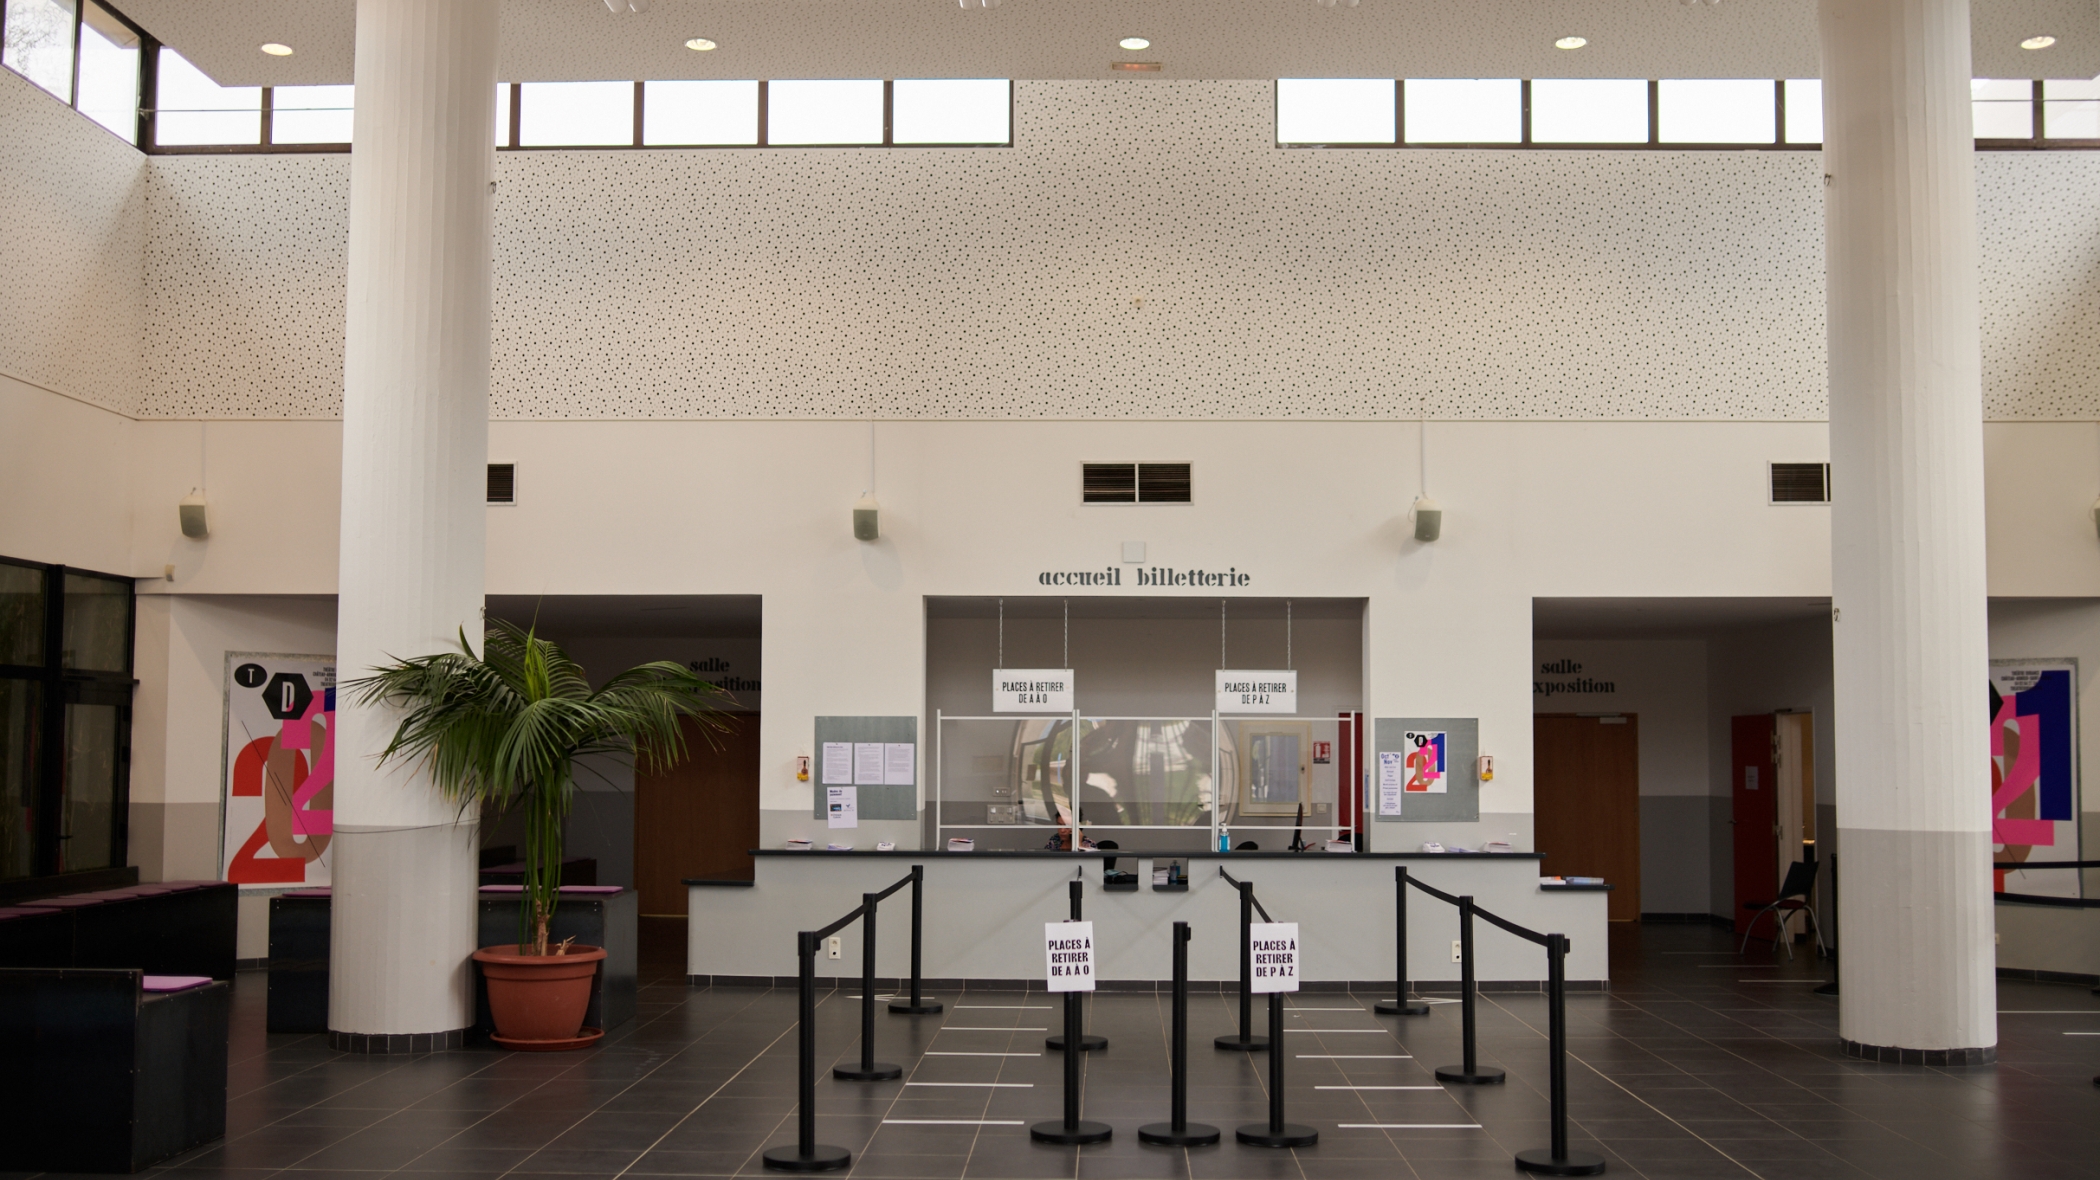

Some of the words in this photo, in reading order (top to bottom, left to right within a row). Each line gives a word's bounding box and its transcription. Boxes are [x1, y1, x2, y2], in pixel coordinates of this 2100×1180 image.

[1038, 567, 1121, 586] accueil
[1137, 567, 1250, 587] billetterie
[689, 658, 730, 672] salle
[1541, 659, 1582, 674] salle
[1002, 681, 1028, 692] PLACES
[1029, 680, 1034, 692] À
[1036, 681, 1064, 692] RETIRER
[1224, 682, 1250, 693] PLACES
[1251, 680, 1257, 693] À
[1258, 682, 1287, 693] RETIRER
[1533, 678, 1616, 697] xposition
[1019, 693, 1027, 704] DE
[1029, 693, 1034, 704] A
[1036, 692, 1041, 704] À
[1042, 693, 1048, 704] O
[1241, 694, 1251, 705] DE
[1252, 694, 1257, 705] P
[1259, 692, 1264, 705] À
[1265, 694, 1270, 705] Z
[1048, 939, 1082, 951] PLACES
[1084, 936, 1091, 949] À
[1253, 940, 1287, 951] PLACES
[1289, 937, 1296, 951] À
[1051, 951, 1089, 964] RETIRER
[1256, 953, 1293, 964] RETIRER
[1051, 965, 1063, 977] DE
[1065, 965, 1072, 976] A
[1074, 963, 1081, 976] À
[1083, 964, 1090, 975] O
[1256, 966, 1267, 977] DE
[1270, 966, 1277, 977] P
[1279, 964, 1286, 977] À
[1288, 966, 1294, 977] Z
